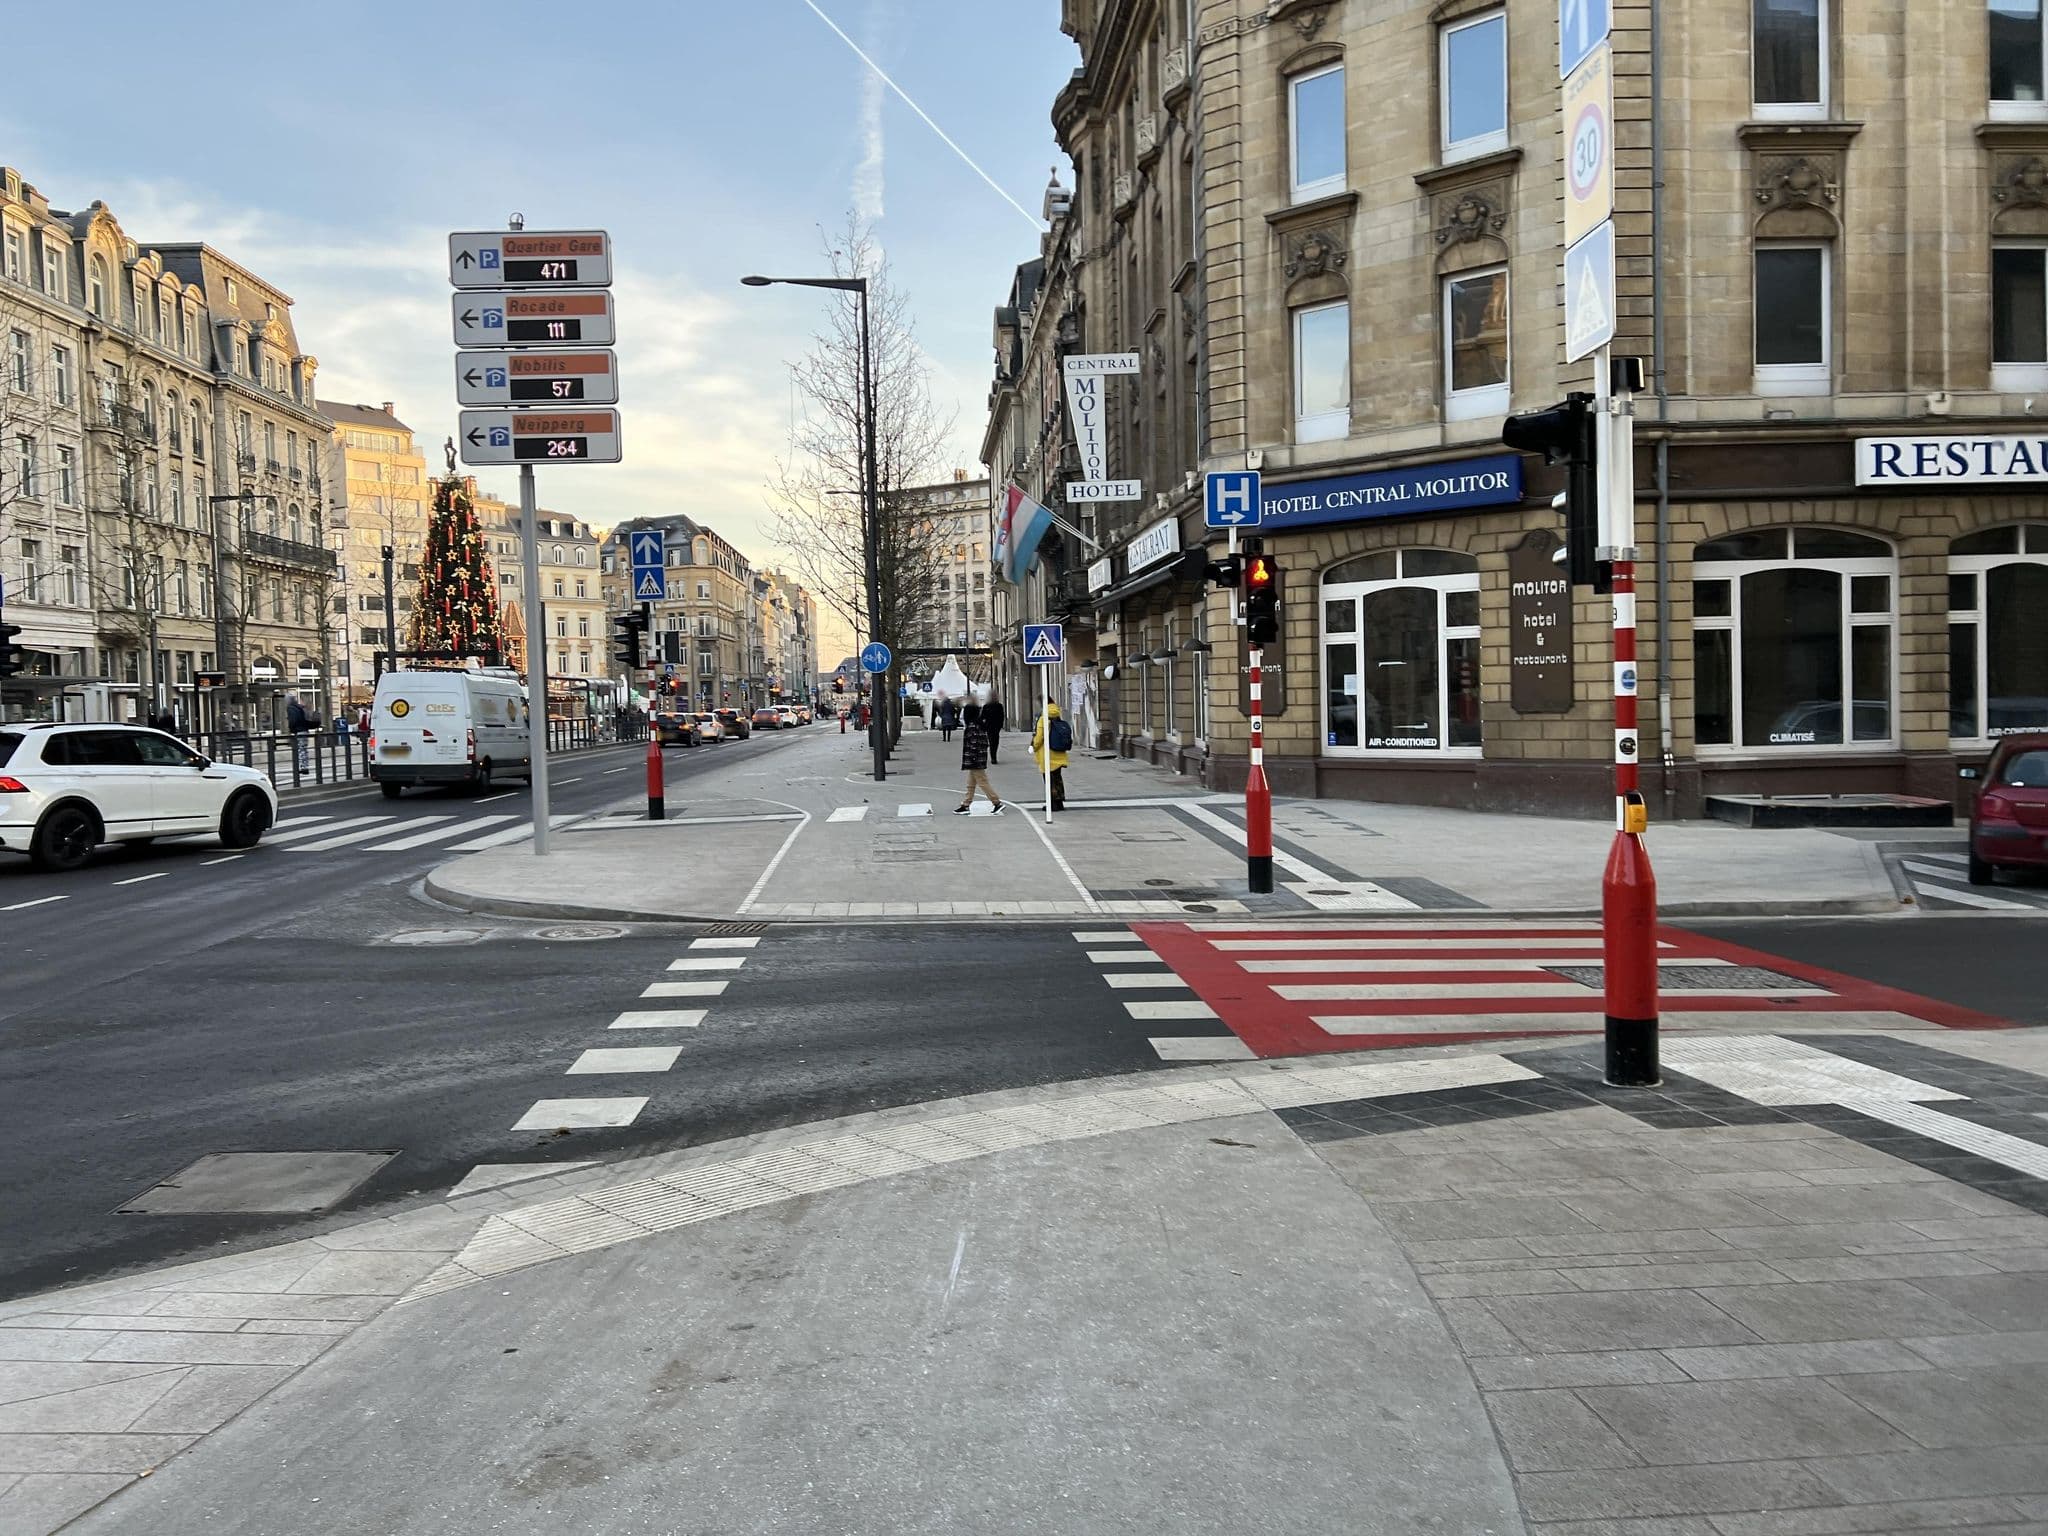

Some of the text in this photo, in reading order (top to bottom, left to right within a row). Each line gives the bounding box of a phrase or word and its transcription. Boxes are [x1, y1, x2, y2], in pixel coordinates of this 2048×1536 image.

[1568, 57, 1602, 101] ZONE
[1577, 128, 1597, 178] 30
[506, 239, 601, 253] Quartier Gare
[540, 263, 566, 279] 471
[510, 300, 565, 313] Rocade
[547, 323, 565, 338] 111
[512, 359, 566, 372] Nobilis
[1067, 358, 1137, 370] CENTRAL
[552, 381, 571, 396] 57
[515, 417, 585, 433] Neipperg
[1075, 377, 1101, 480] MOLITOR
[547, 440, 577, 456] 264
[1071, 483, 1137, 498] HOTEL
[1216, 477, 1250, 512] H
[1263, 471, 1510, 516] HOTEL CENTRAL MOLITOR
[1523, 612, 1556, 628] hotel
[1513, 653, 1568, 665] restaurant
[1769, 730, 1815, 742] CLIMATISÉ
